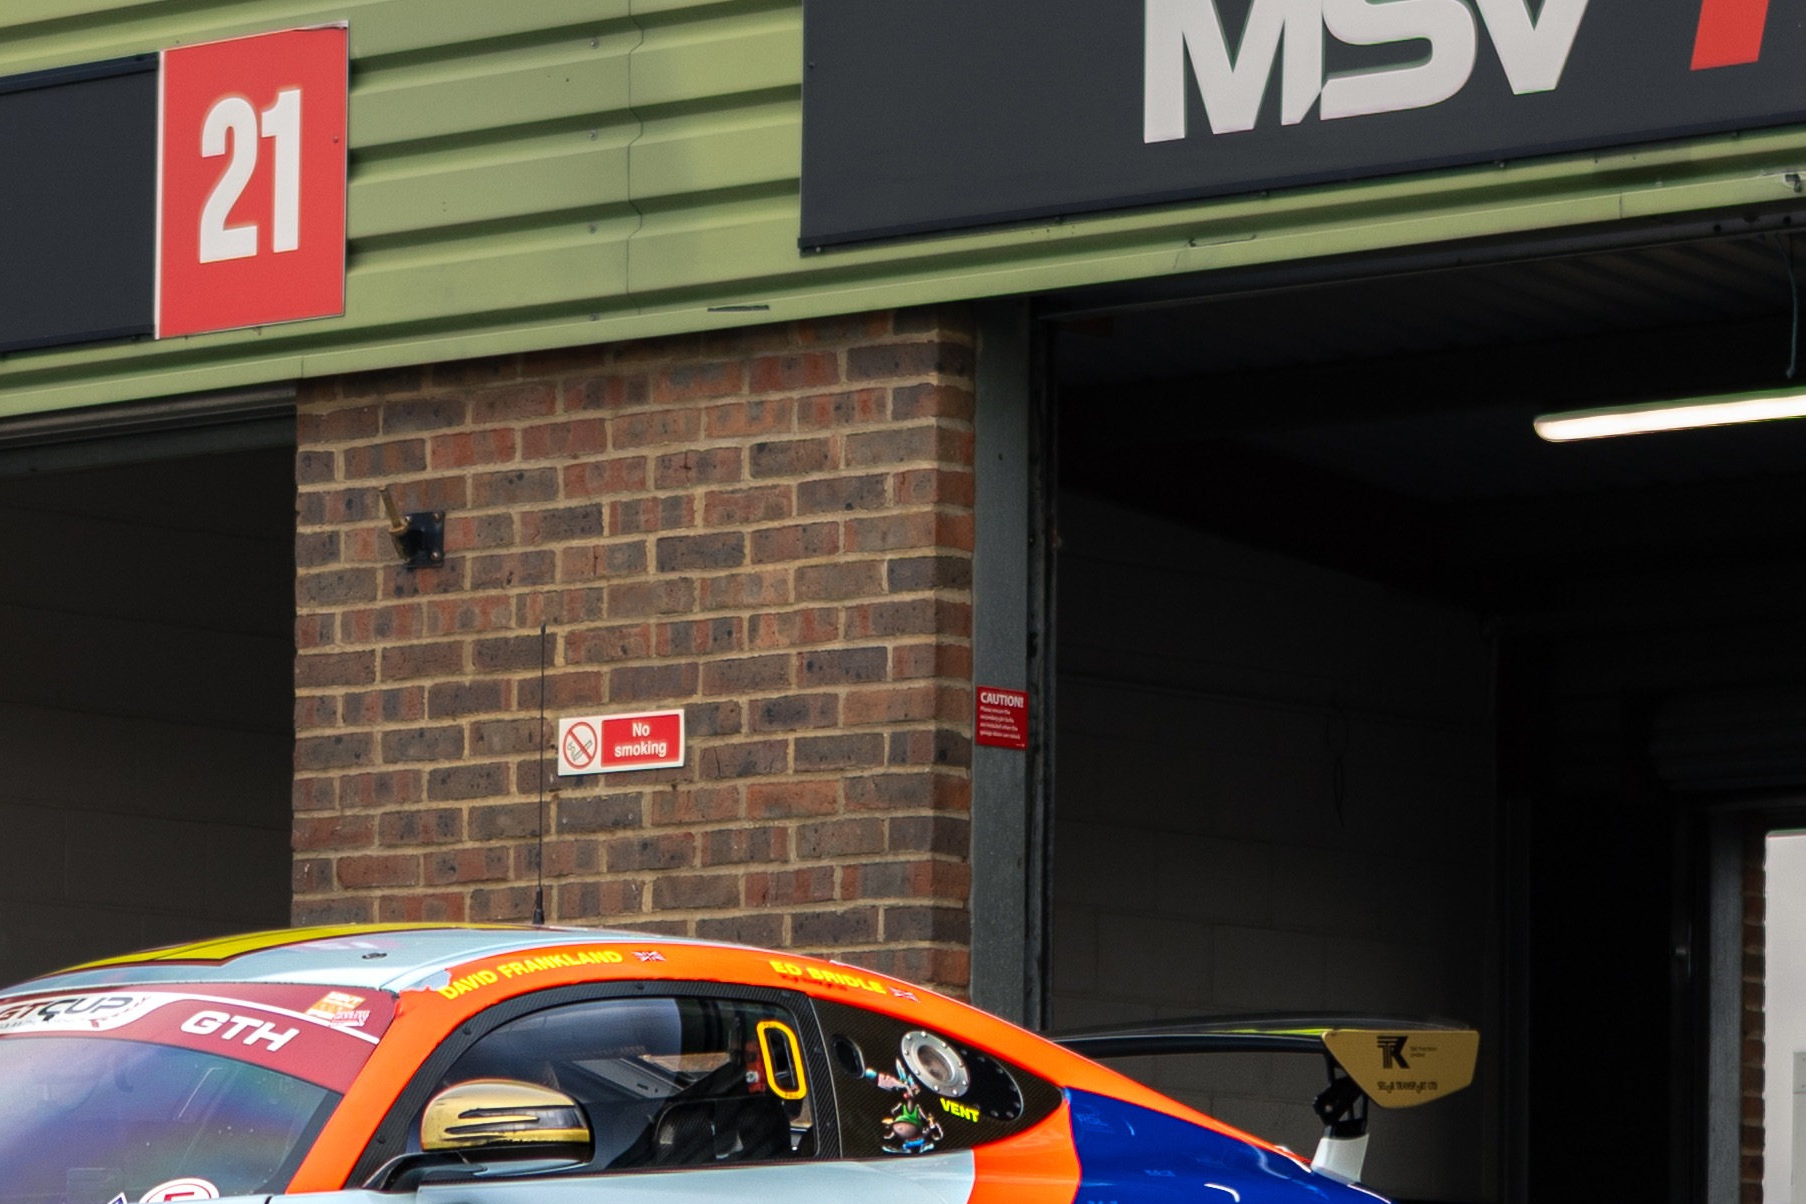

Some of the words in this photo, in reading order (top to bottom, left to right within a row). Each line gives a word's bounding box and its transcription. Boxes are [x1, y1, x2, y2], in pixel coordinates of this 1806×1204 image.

[199, 89, 302, 264] 21
[980, 691, 1024, 708] CAUTION!
[632, 722, 650, 738] No
[614, 741, 667, 758] smoking
[437, 970, 498, 1000] DAVID
[497, 950, 623, 979] FRANKLAND
[769, 960, 803, 976] ED
[806, 967, 887, 995] BRIDLE
[180, 1010, 300, 1052] GTH
[940, 1098, 980, 1122] VENT
